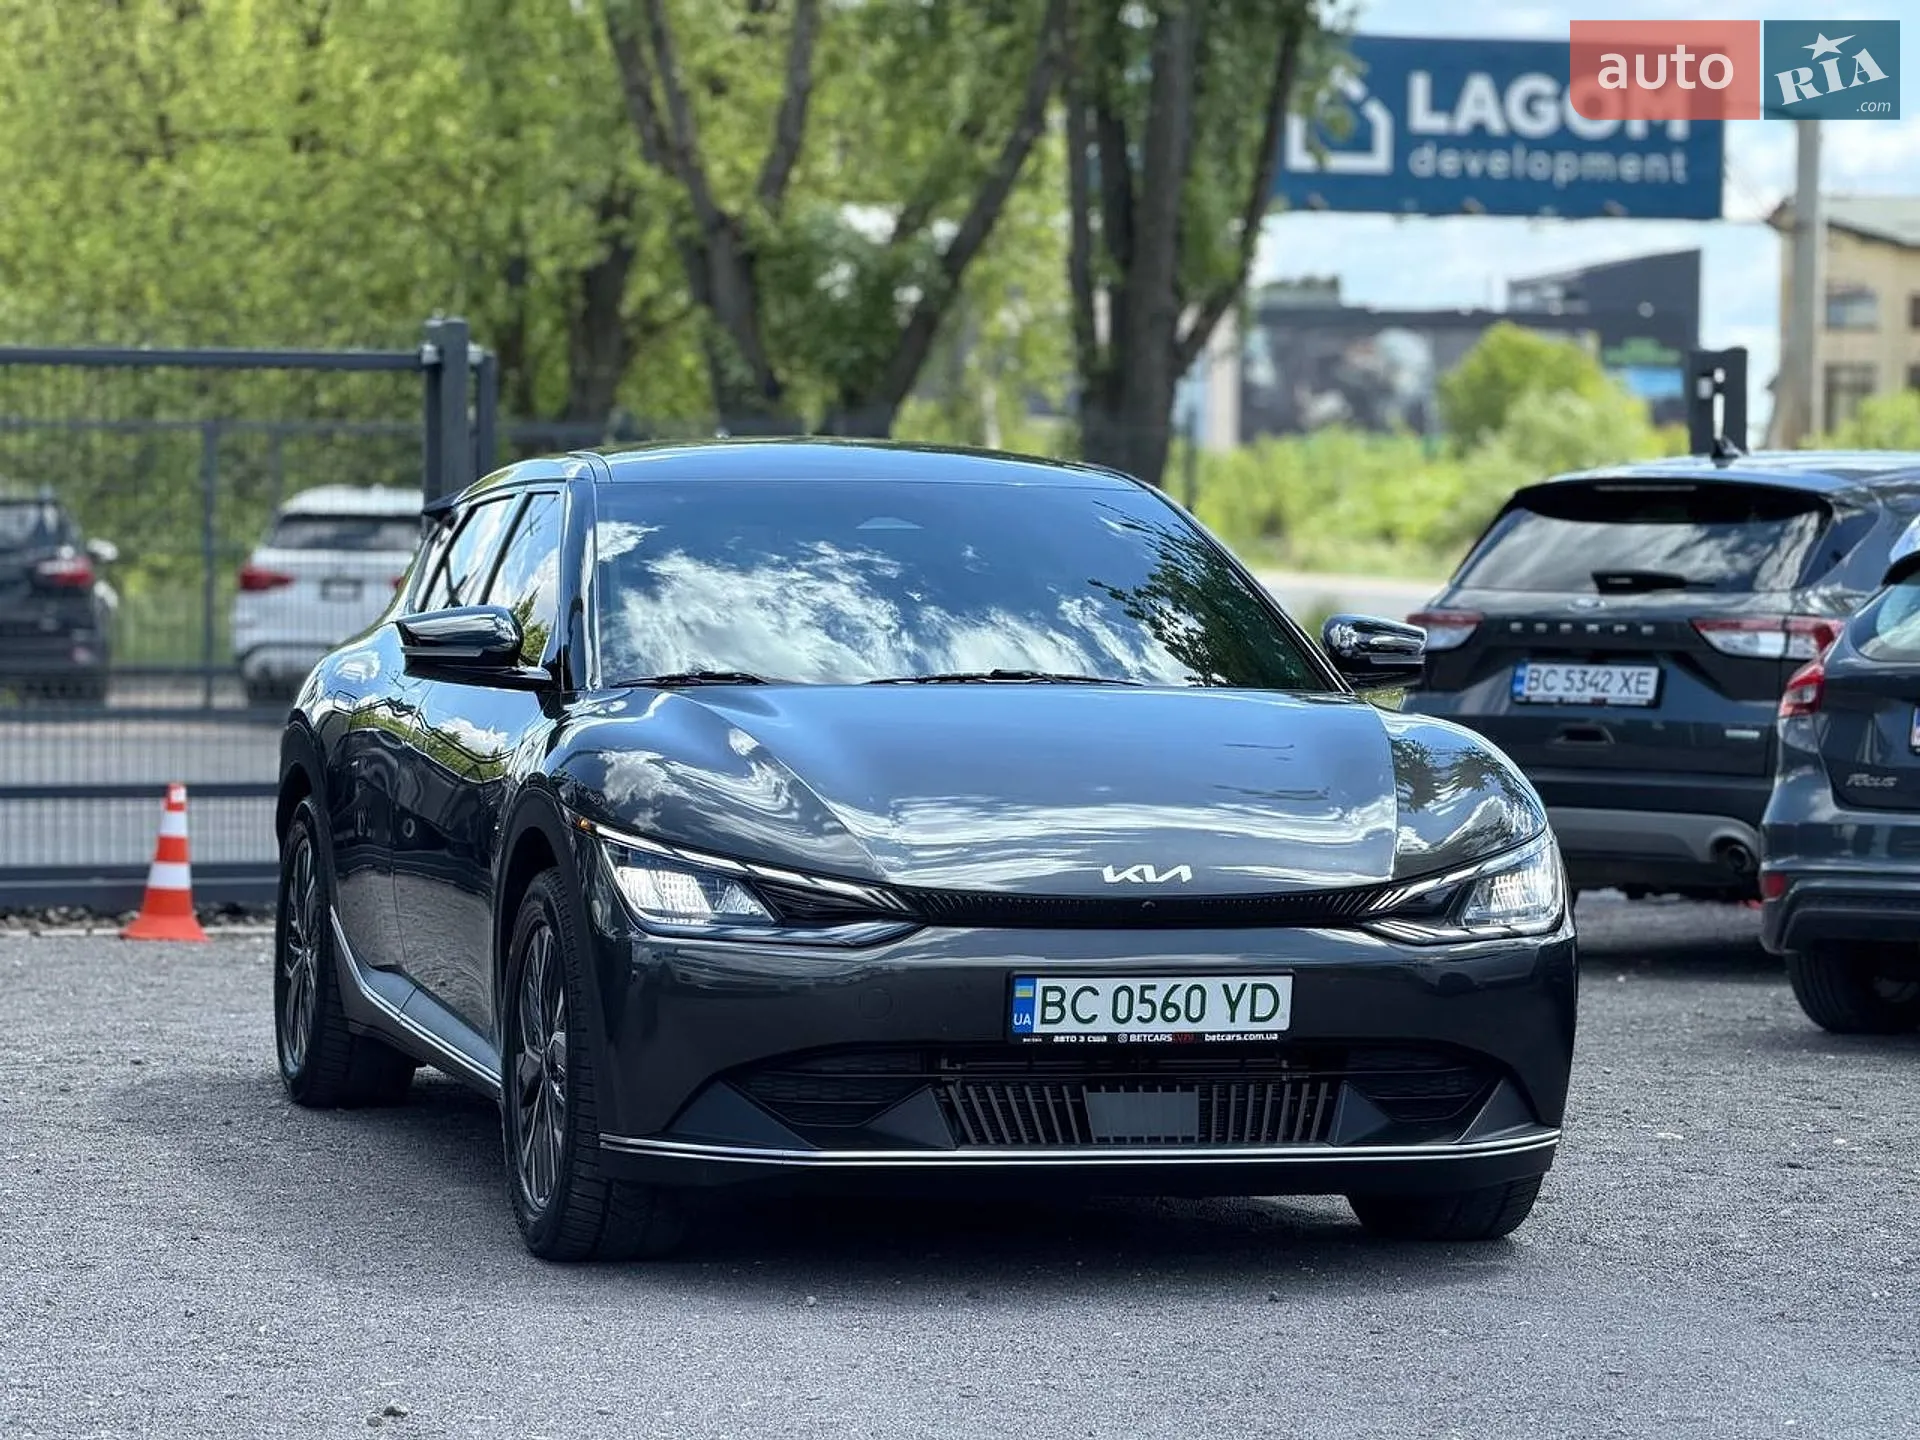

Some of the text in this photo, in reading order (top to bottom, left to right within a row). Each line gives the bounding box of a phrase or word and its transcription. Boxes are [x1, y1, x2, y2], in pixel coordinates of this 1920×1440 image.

[1407, 141, 1688, 189] development
[1528, 667, 1653, 696] BC 5342 XE
[1102, 864, 1193, 884] KIA
[1040, 983, 1281, 1025] BC 0560 YD
[1013, 1013, 1031, 1026] UA
[1204, 1033, 1279, 1042] betcars.com.ua
